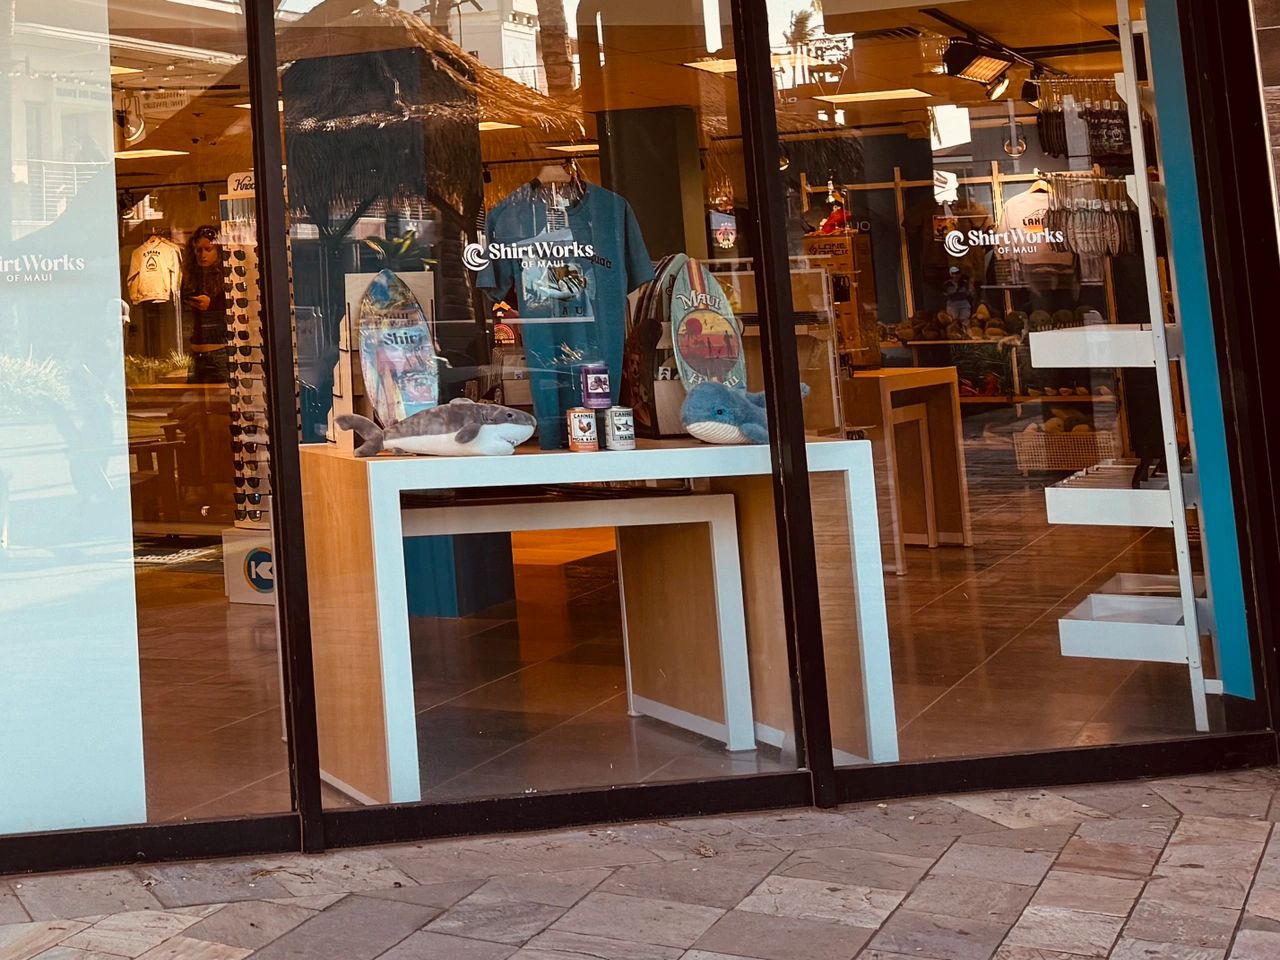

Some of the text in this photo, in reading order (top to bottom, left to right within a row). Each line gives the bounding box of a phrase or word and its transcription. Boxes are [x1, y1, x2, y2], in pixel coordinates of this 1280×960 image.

[968, 228, 1064, 246] ShirtWorks
[488, 241, 594, 259] ShirtWorks
[1013, 246, 1037, 254] MAUI
[537, 259, 564, 268] MAUI
[6, 273, 52, 282] OF MAUI
